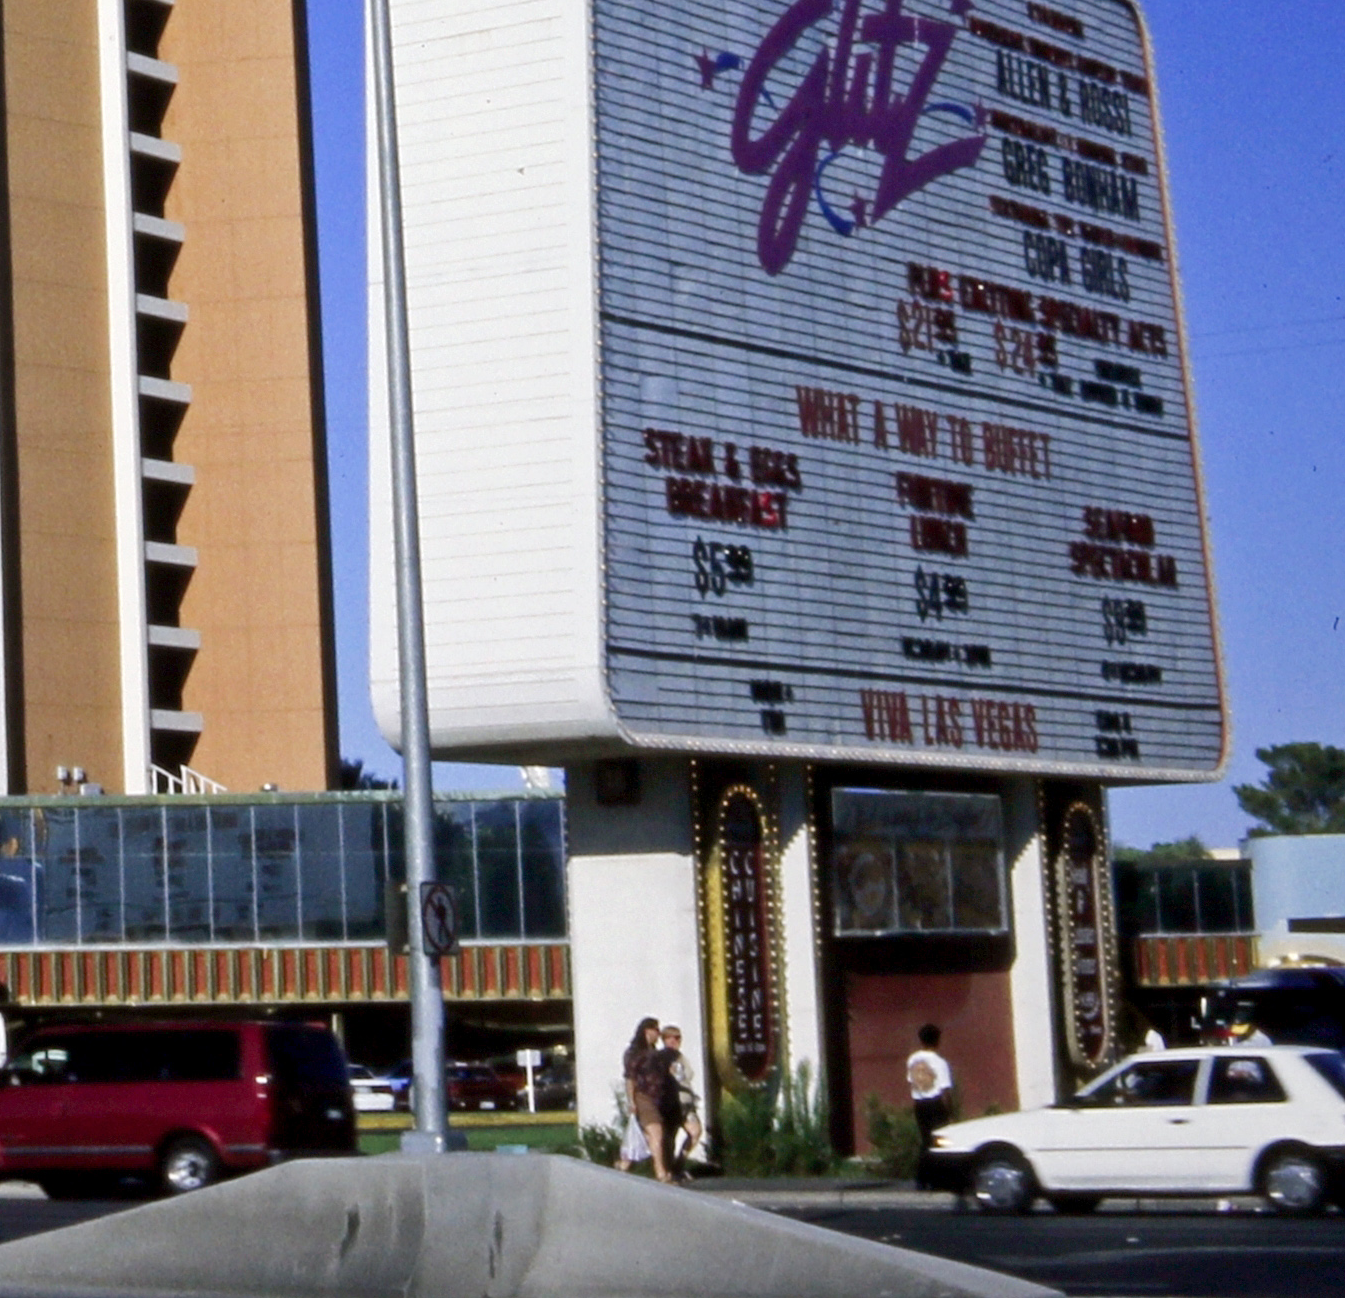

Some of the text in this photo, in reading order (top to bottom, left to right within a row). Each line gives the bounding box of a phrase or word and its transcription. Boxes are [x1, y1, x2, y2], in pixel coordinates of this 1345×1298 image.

[997, 49, 1052, 109] ALLEN
[1059, 71, 1071, 117] &
[1079, 79, 1133, 137] ROSSI
[1002, 137, 1051, 196] GREG
[1062, 156, 1141, 222] BONHAM
[1023, 230, 1071, 284] COPA
[1080, 246, 1131, 302] GIRLS
[642, 428, 715, 476] STEAK
[724, 442, 740, 483] &
[795, 385, 1051, 481] WHAT A WAY TO BUFFET
[860, 688, 912, 743] VIVA
[921, 694, 962, 748] LAS
[971, 698, 1038, 753] VEGAS
[728, 849, 748, 1040] CHINESE
[743, 849, 764, 1040] CUISINE
